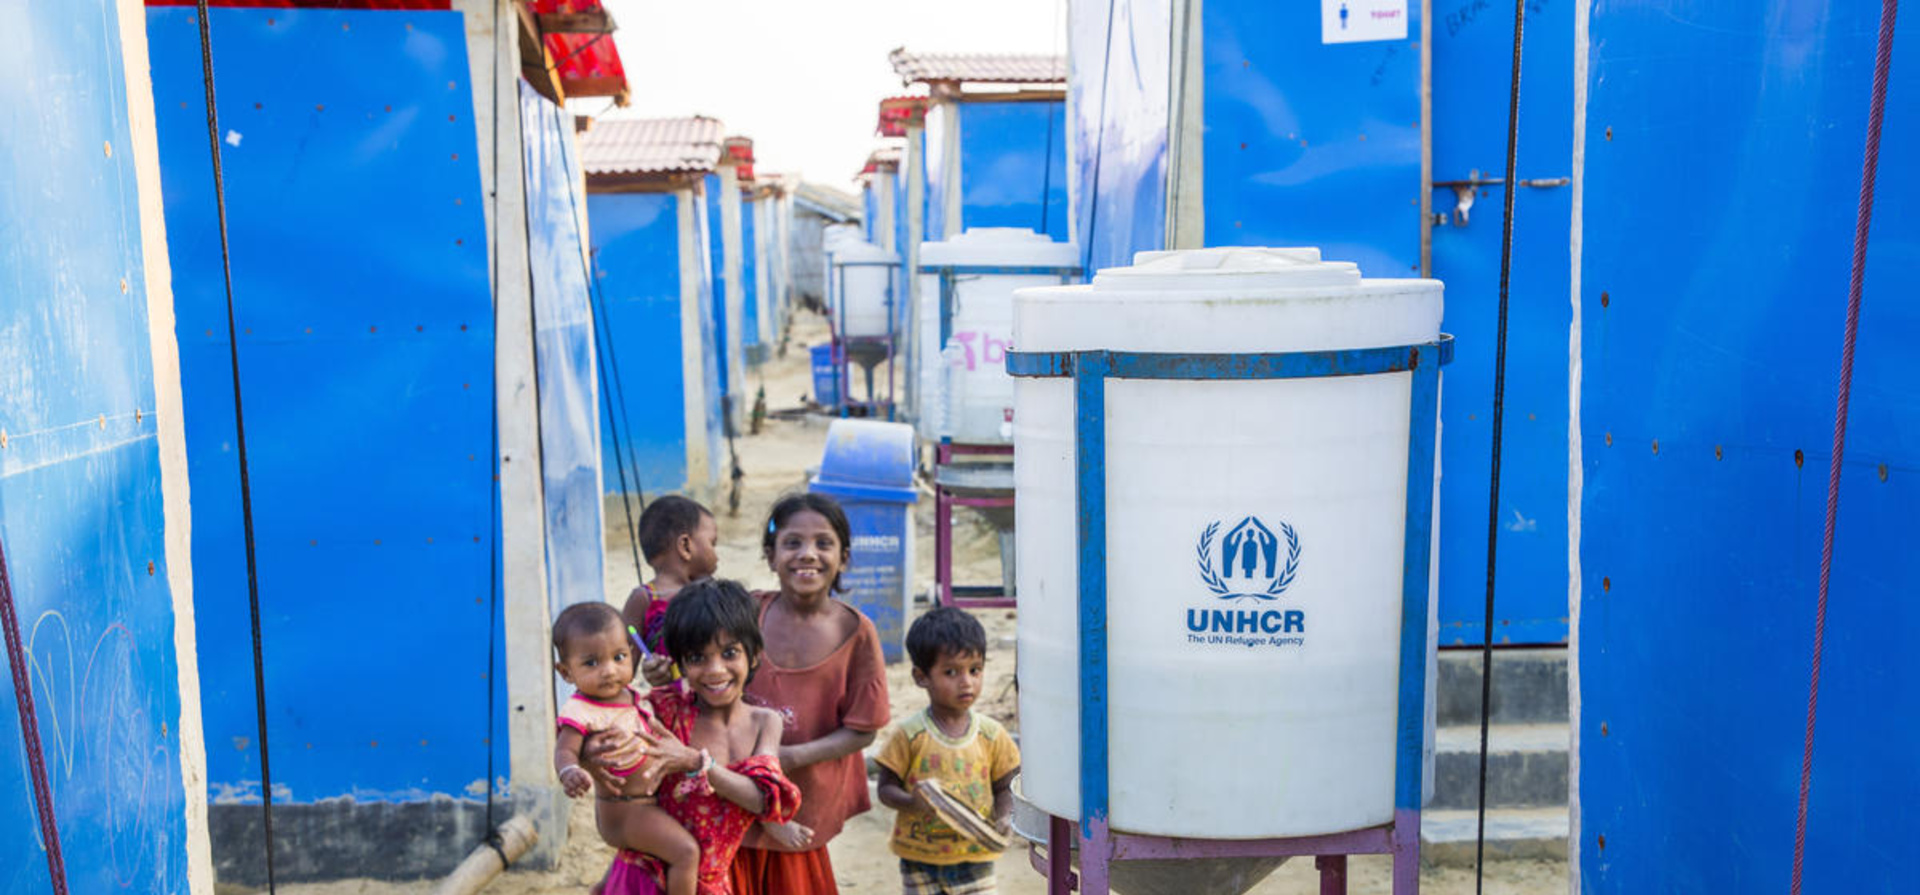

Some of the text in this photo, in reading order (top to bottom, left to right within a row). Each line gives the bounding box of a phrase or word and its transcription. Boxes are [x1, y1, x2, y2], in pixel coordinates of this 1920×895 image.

[1187, 608, 1305, 633] UNHCR
[1187, 634, 1305, 648] The UN Refugee Agency
